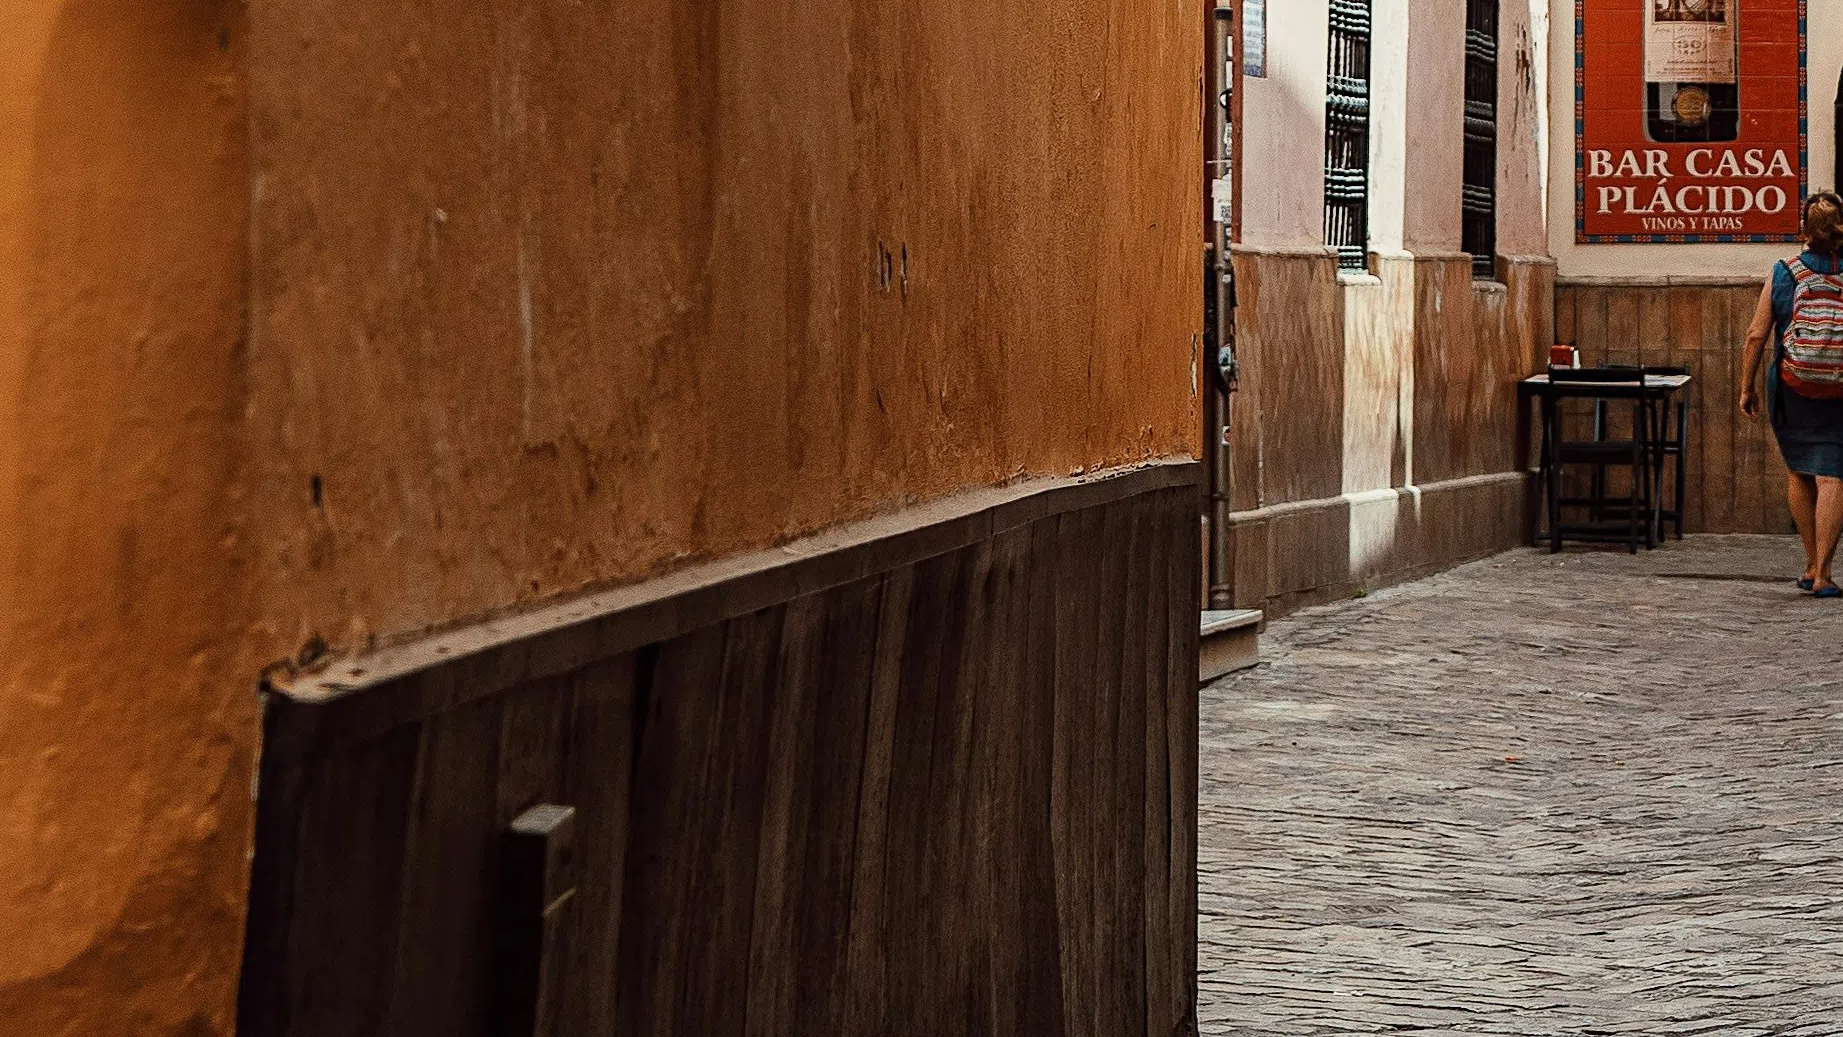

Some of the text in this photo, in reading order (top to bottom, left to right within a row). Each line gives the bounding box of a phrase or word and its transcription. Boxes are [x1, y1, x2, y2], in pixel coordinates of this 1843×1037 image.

[1587, 148, 1796, 178] BAR CASA
[1596, 176, 1787, 215] PLÁCIDO
[1640, 216, 1744, 231] VINOS Y TAPAS
